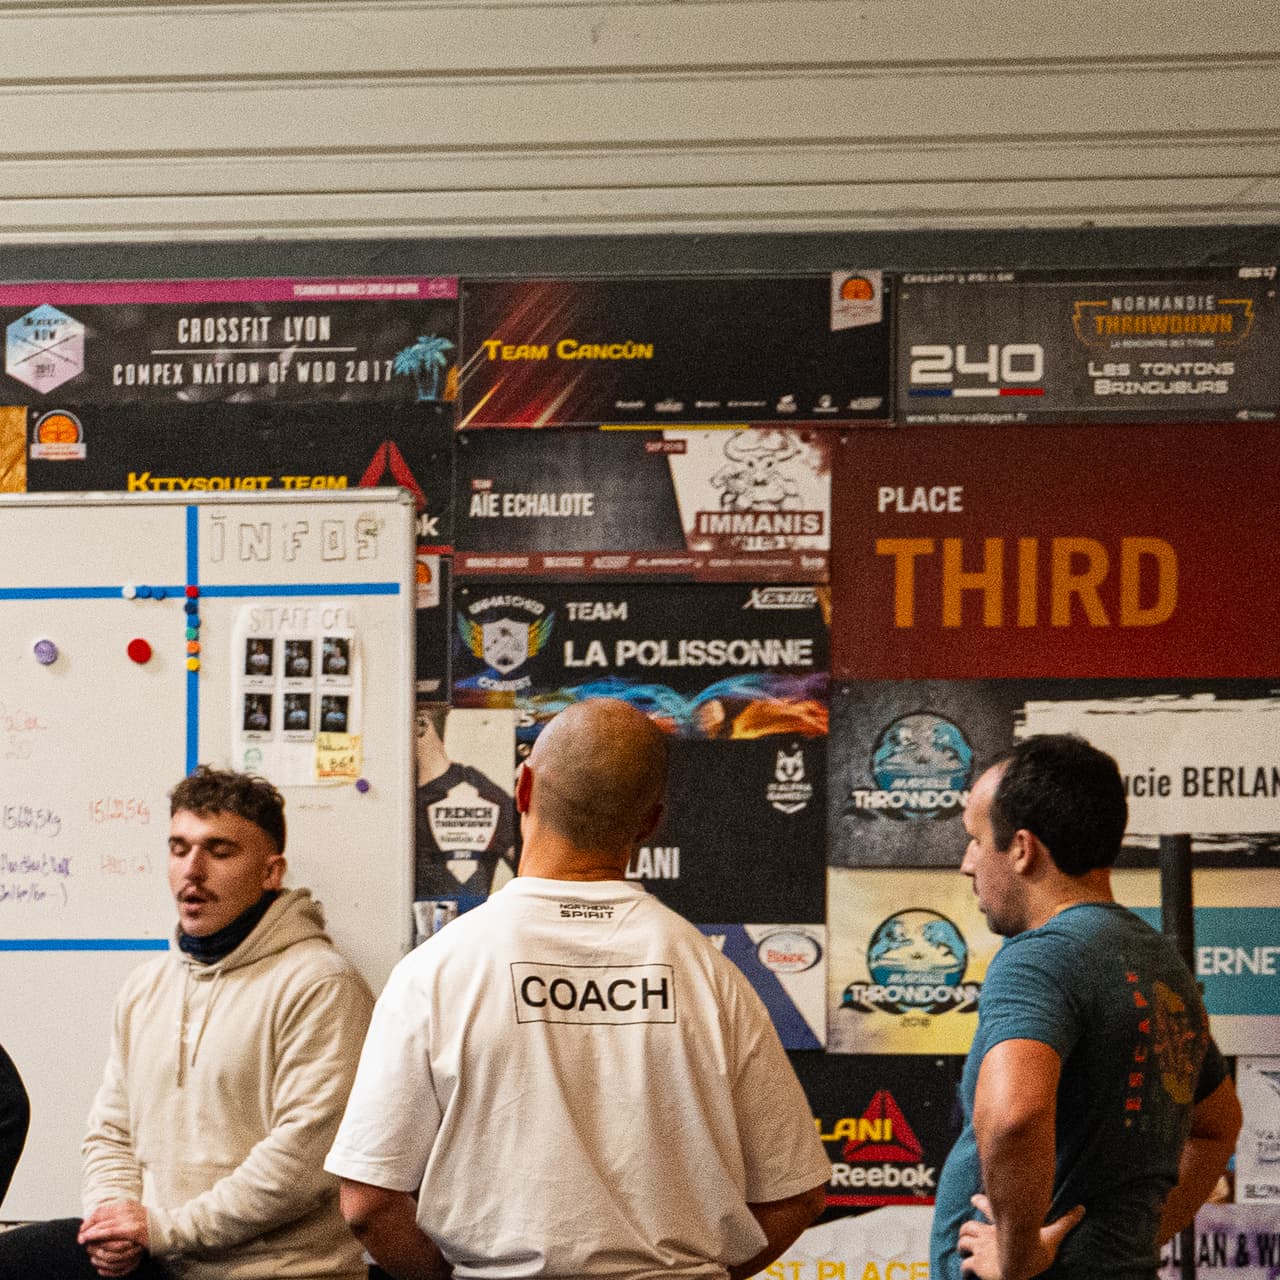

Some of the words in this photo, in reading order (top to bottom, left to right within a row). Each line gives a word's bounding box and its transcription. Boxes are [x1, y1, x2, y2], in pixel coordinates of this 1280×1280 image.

[1111, 296, 1215, 311] NORMANDIE
[177, 316, 268, 343] CROSSFIT
[284, 315, 331, 342] LYON
[1094, 313, 1233, 335] THROWDOWN
[113, 362, 184, 386] COMPEX
[192, 362, 260, 385] NATION
[268, 361, 289, 385] OF
[297, 360, 335, 384] WOD
[345, 359, 394, 383] 2017
[909, 343, 1044, 384] 240
[502, 491, 595, 517] ECHALOTE
[877, 486, 964, 513] PLACE
[699, 513, 821, 534] IMMANIS
[875, 536, 1180, 628] THIRD
[566, 602, 628, 621] TEAM
[564, 640, 608, 668] LA
[615, 639, 814, 668] POLISSONNE
[851, 789, 968, 810] THROWDOW
[559, 910, 615, 920] SPIRIT
[520, 974, 670, 1013] COACH
[830, 1162, 937, 1189] Reebok
